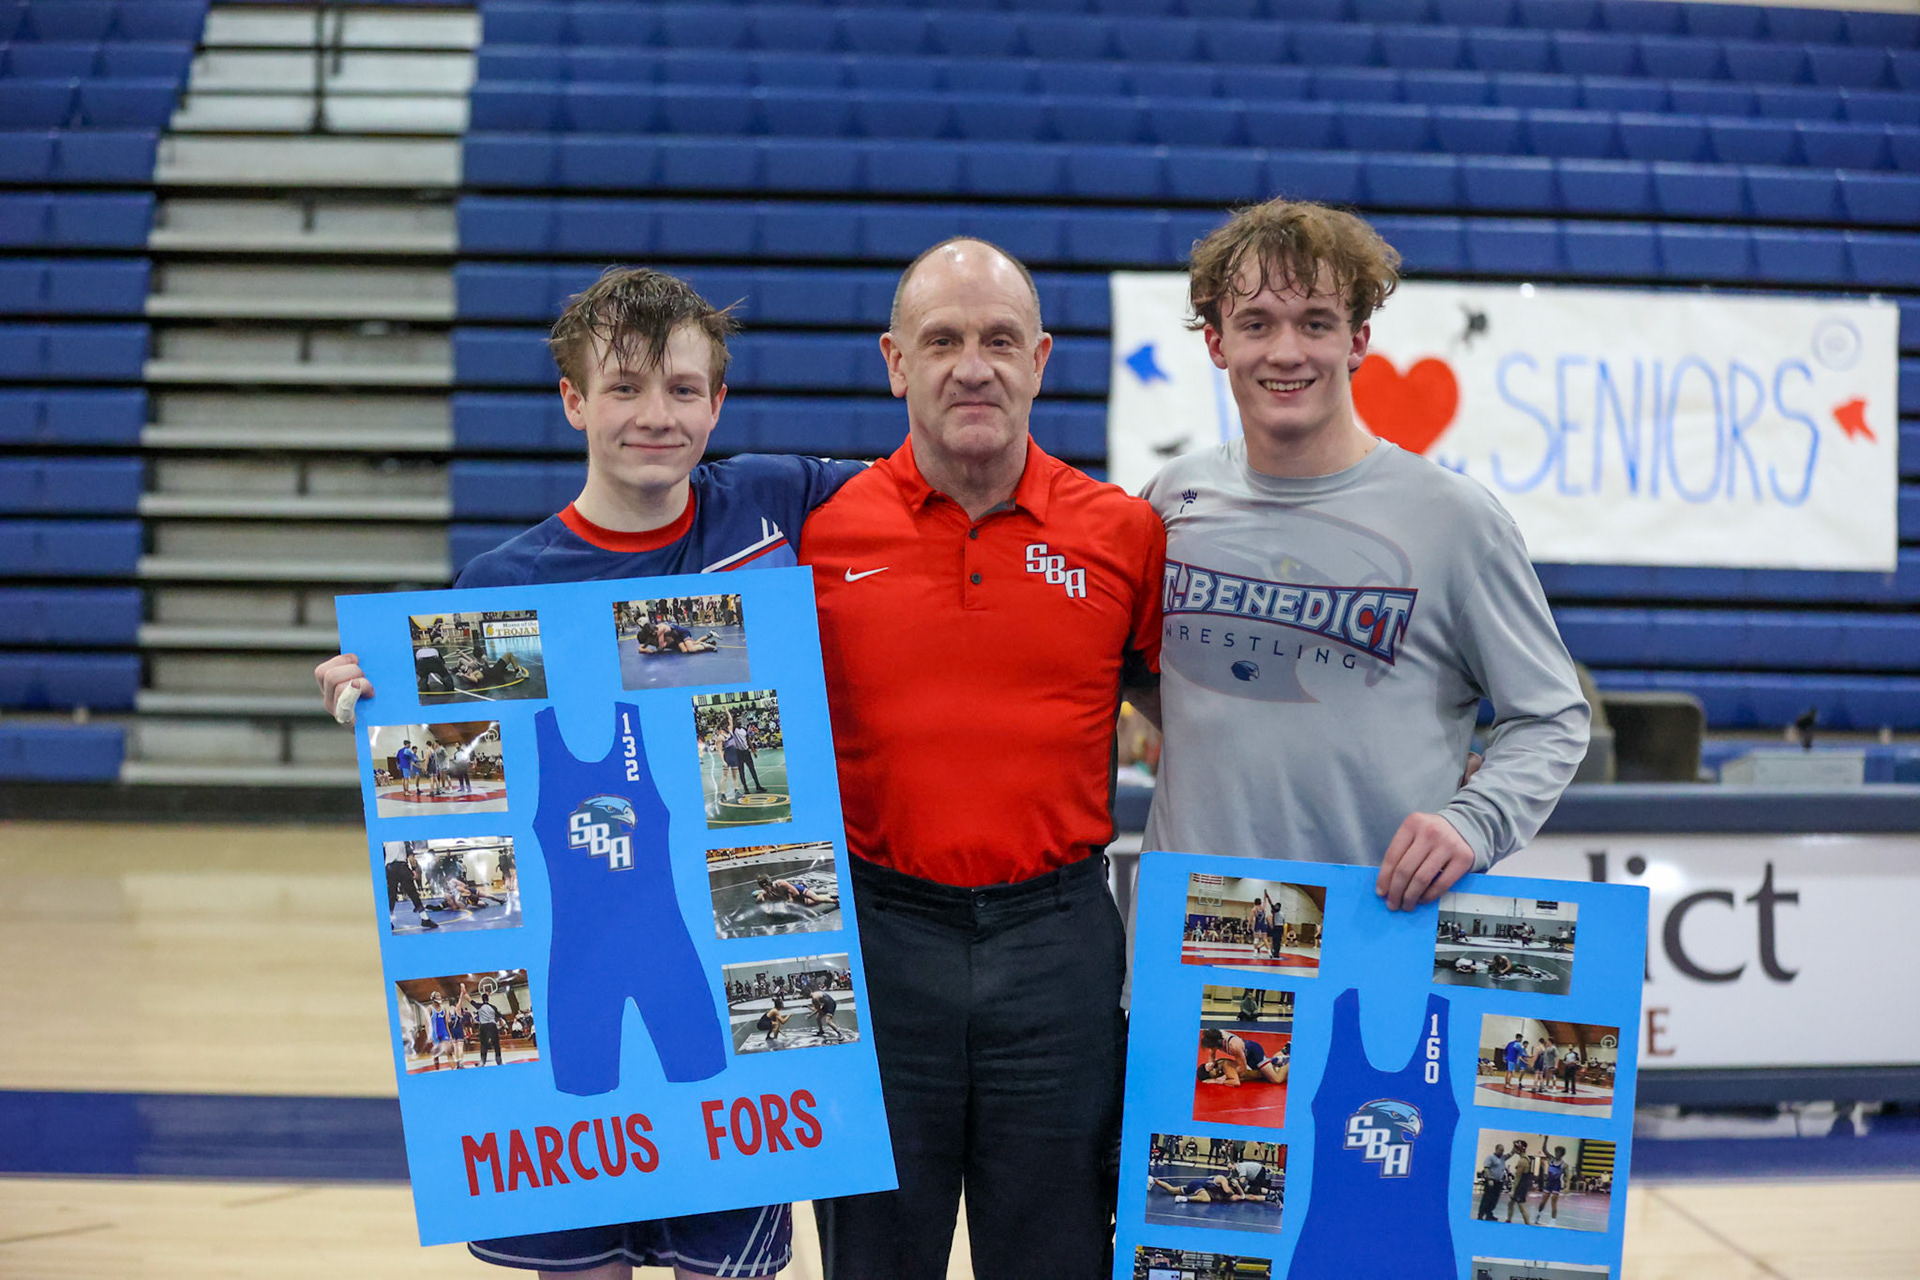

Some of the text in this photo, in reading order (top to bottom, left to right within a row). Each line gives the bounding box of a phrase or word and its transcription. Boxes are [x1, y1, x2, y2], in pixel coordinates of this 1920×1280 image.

[1491, 351, 1820, 507] SENIORS
[1025, 543, 1087, 598] SBA
[1165, 624, 1356, 669] WRESTLING
[569, 811, 633, 870] SBA
[461, 1089, 823, 1197] MARCUS FORS
[1345, 1114, 1411, 1176] SBA
